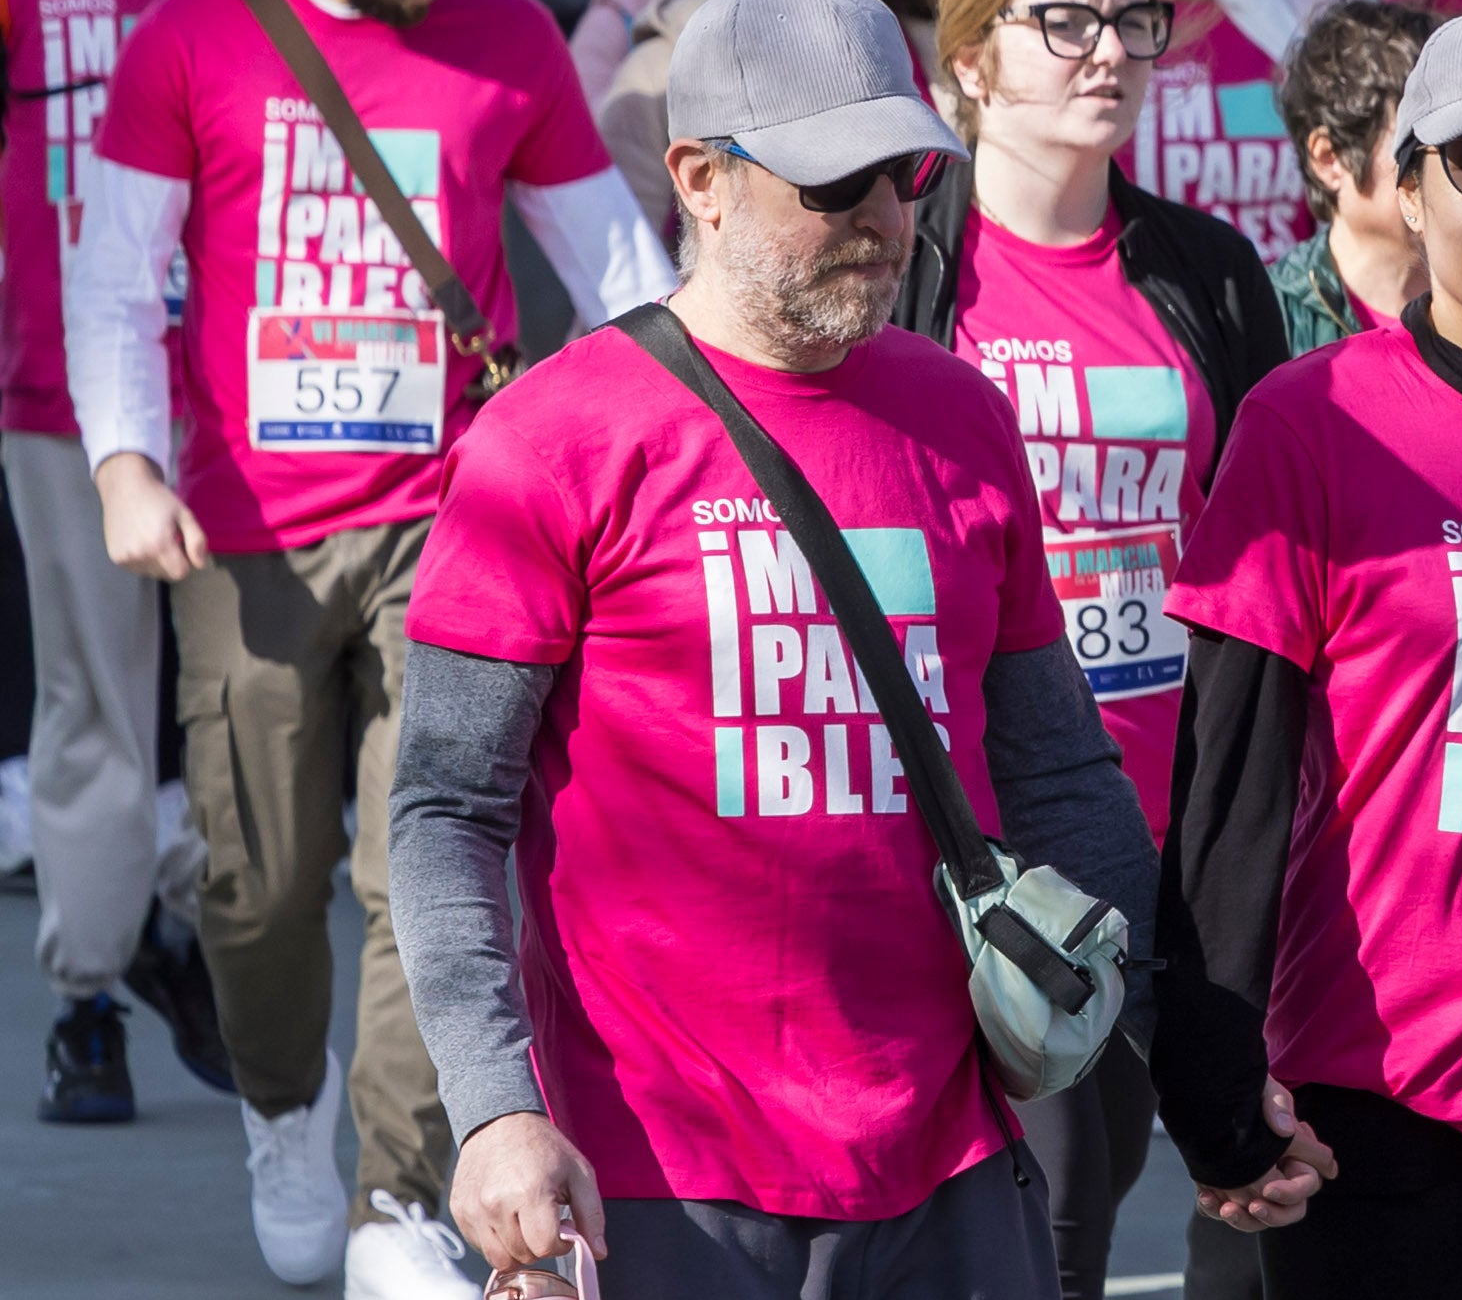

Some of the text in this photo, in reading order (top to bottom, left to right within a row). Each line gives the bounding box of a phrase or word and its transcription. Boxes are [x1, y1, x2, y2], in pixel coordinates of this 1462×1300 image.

[265, 96, 325, 122] SOM
[296, 367, 401, 414] 557
[1025, 442, 1186, 522] PARA
[692, 497, 785, 525] SOMO
[1075, 542, 1161, 576] MARCHA
[1099, 568, 1165, 599] MUJER
